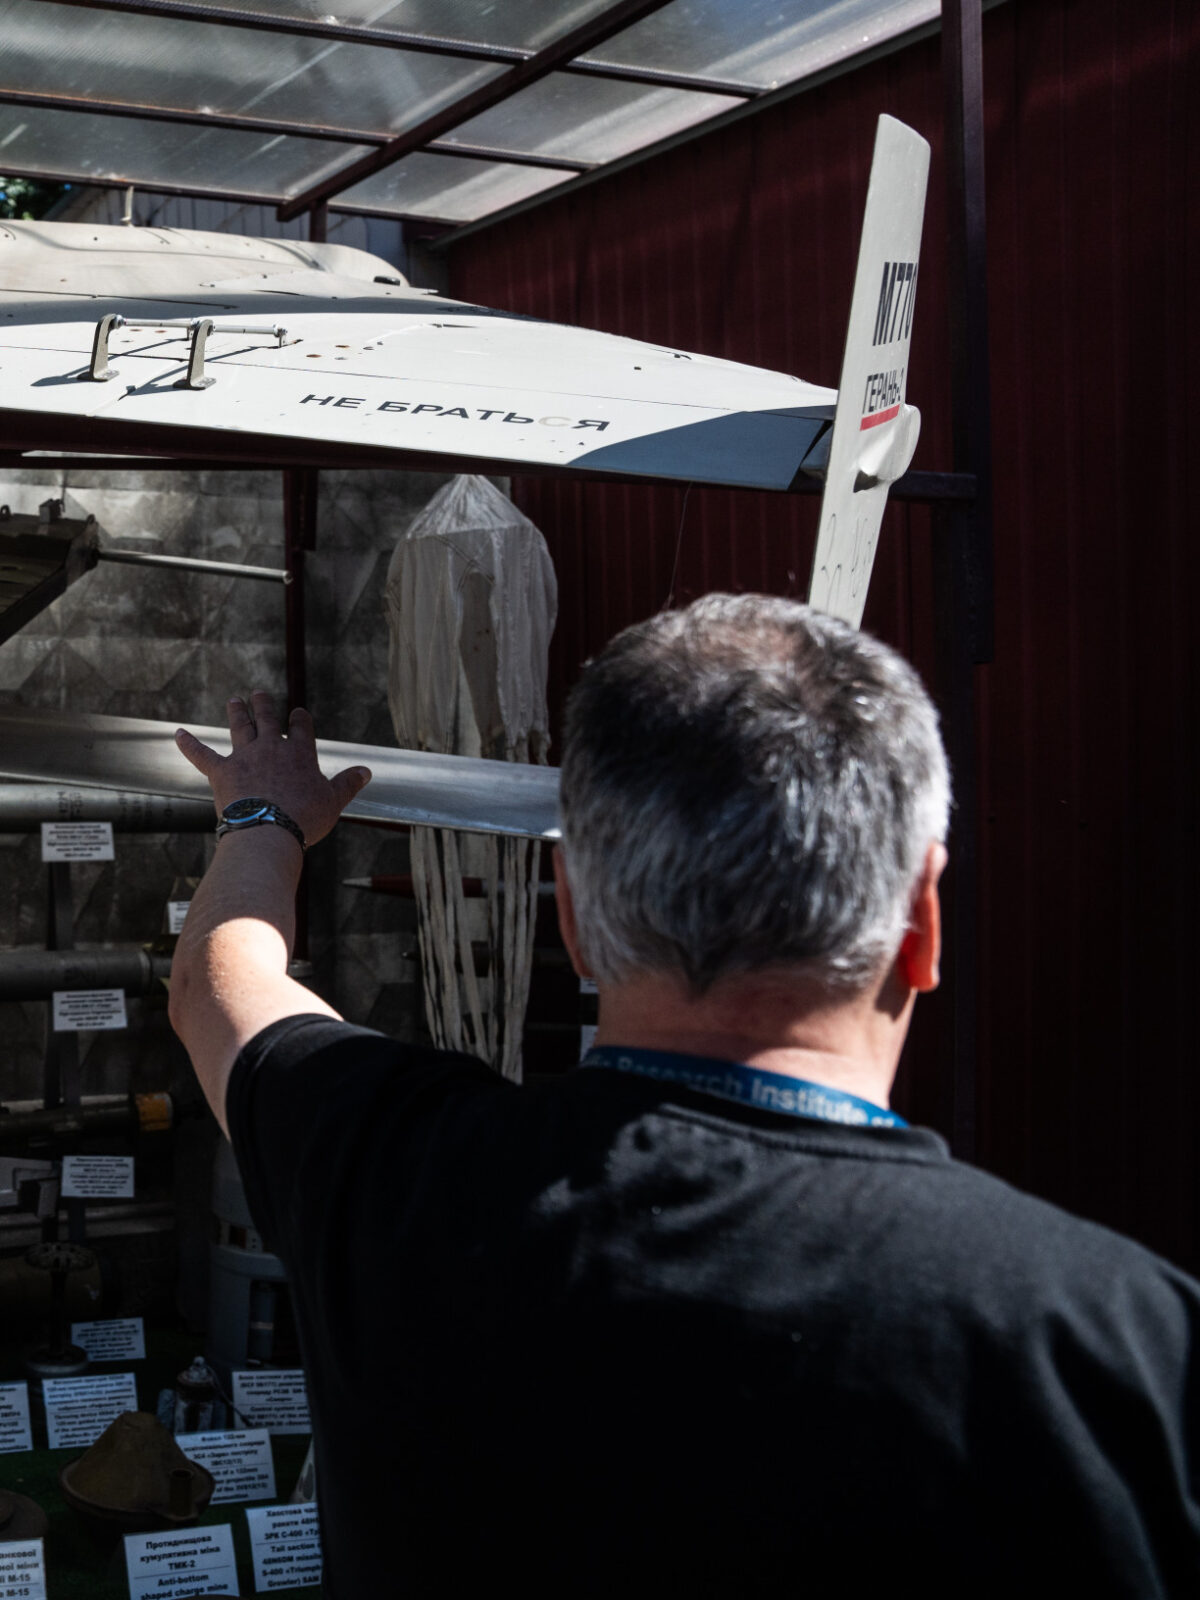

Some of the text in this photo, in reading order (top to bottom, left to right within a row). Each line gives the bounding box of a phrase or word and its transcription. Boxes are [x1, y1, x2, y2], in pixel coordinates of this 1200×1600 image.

[299, 394, 611, 432] НЕ БРАТЬСЯ
[752, 1078, 868, 1126] Institute
